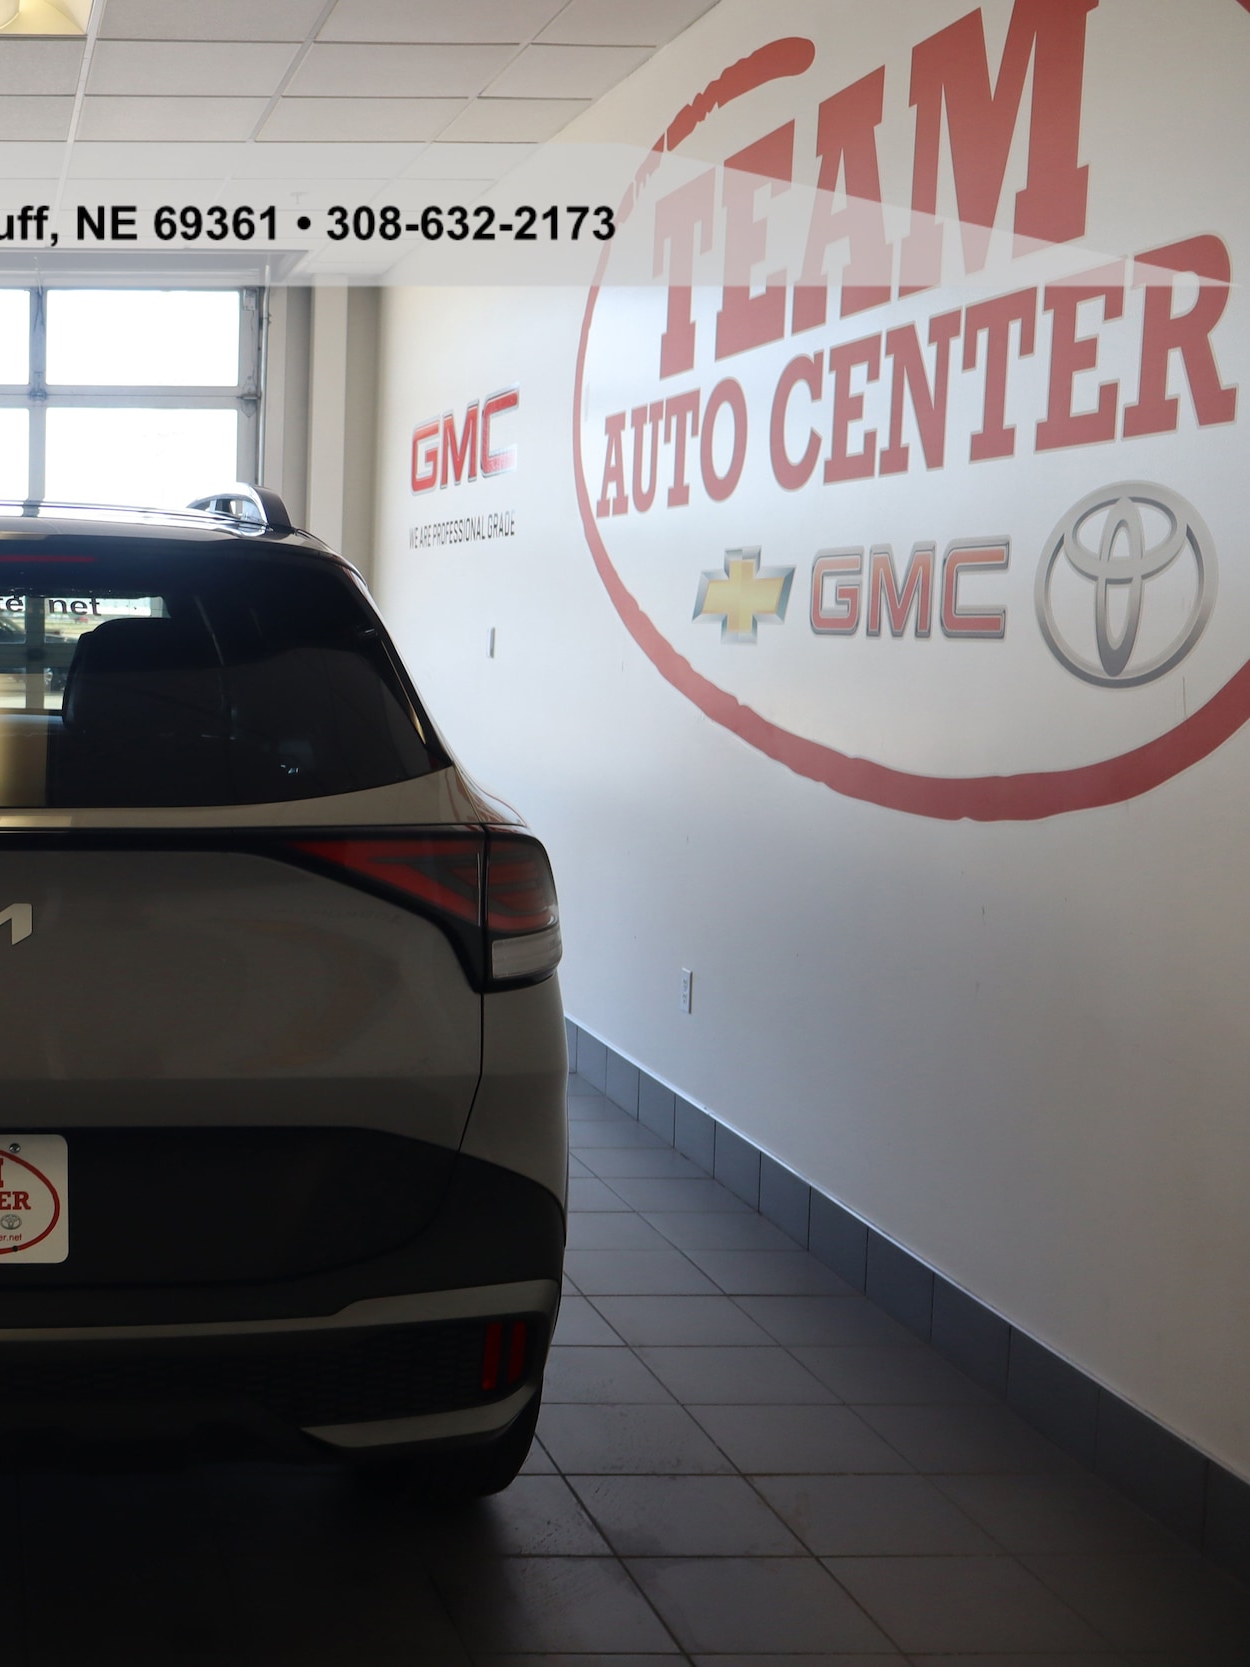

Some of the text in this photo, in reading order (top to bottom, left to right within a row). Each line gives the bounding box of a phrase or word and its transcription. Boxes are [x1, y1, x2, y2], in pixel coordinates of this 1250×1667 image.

[652, 0, 1098, 381] TEAM
[595, 233, 1238, 519] AUTO CENTER
[411, 382, 520, 496] GMC
[409, 510, 515, 549] WE ARE PROFESSIONAL GRADE
[809, 535, 1010, 641] GMC
